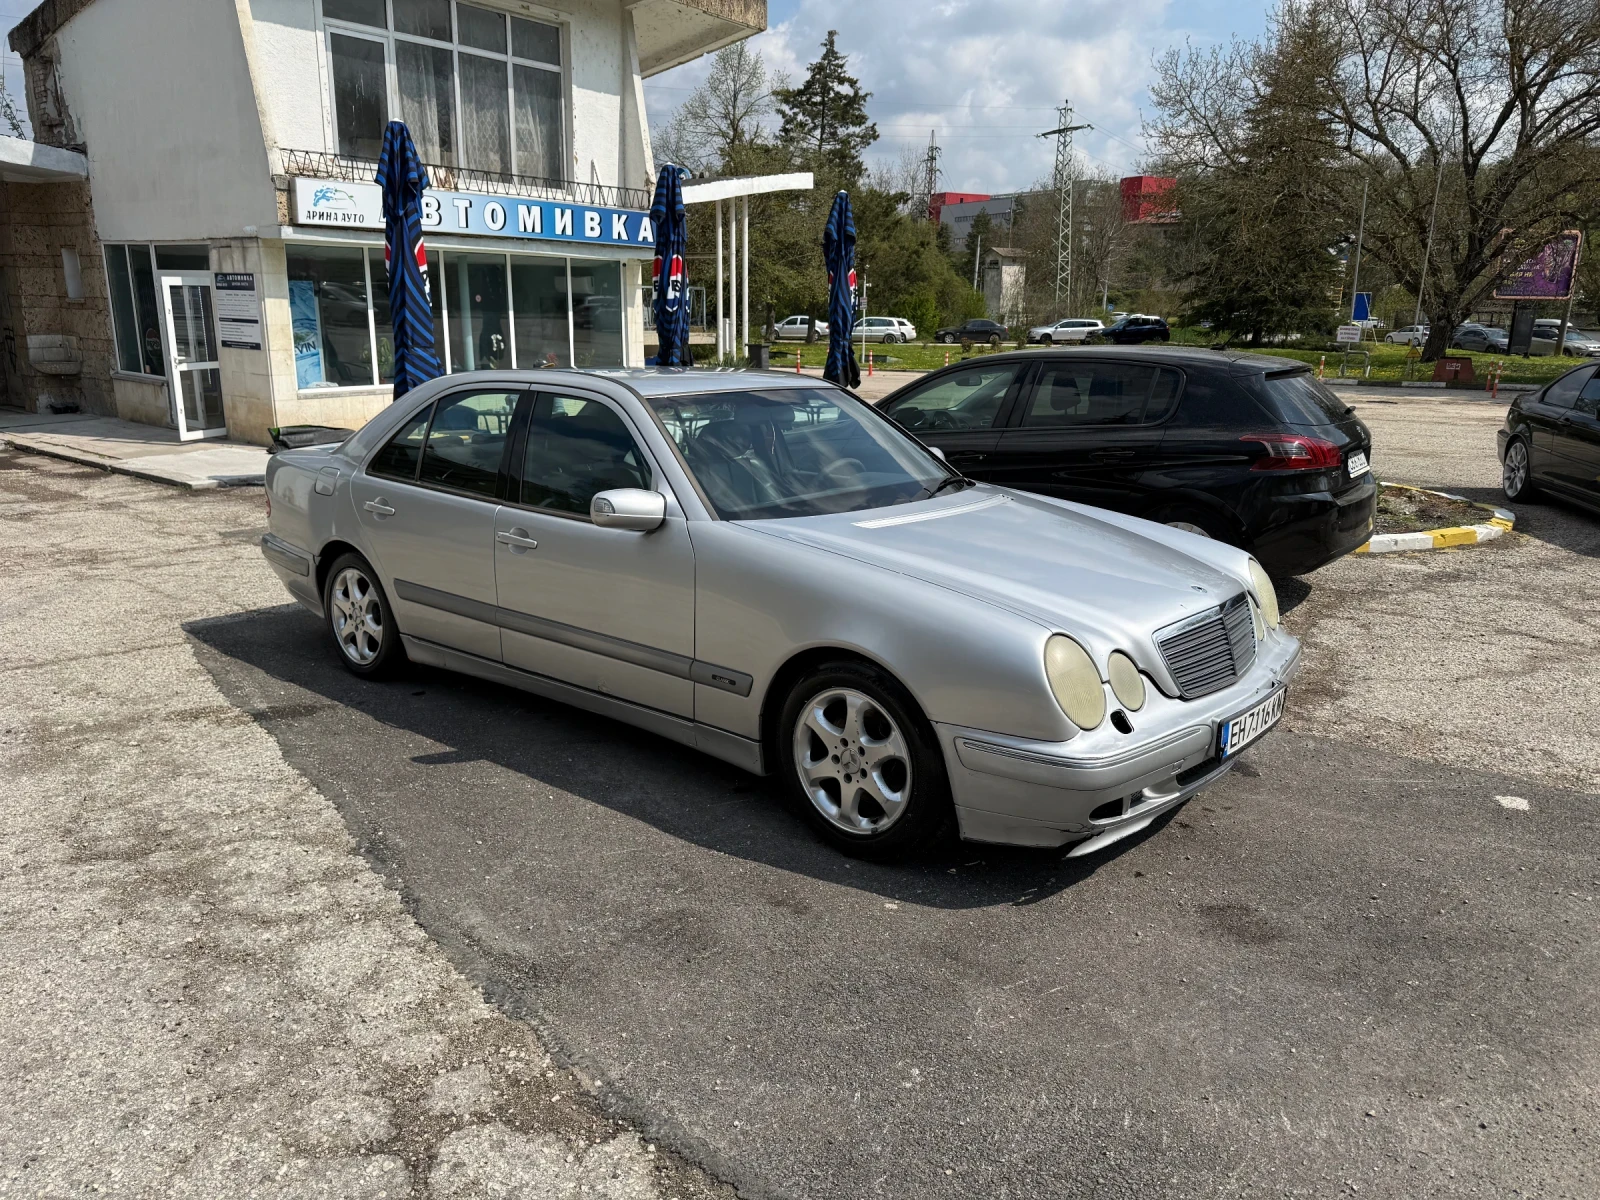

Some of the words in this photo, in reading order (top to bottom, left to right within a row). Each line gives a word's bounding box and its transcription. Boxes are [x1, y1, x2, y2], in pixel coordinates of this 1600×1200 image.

[306, 210, 338, 222] АРИНА
[341, 213, 365, 224] АУТО
[379, 194, 654, 243] ВТОМИВКА
